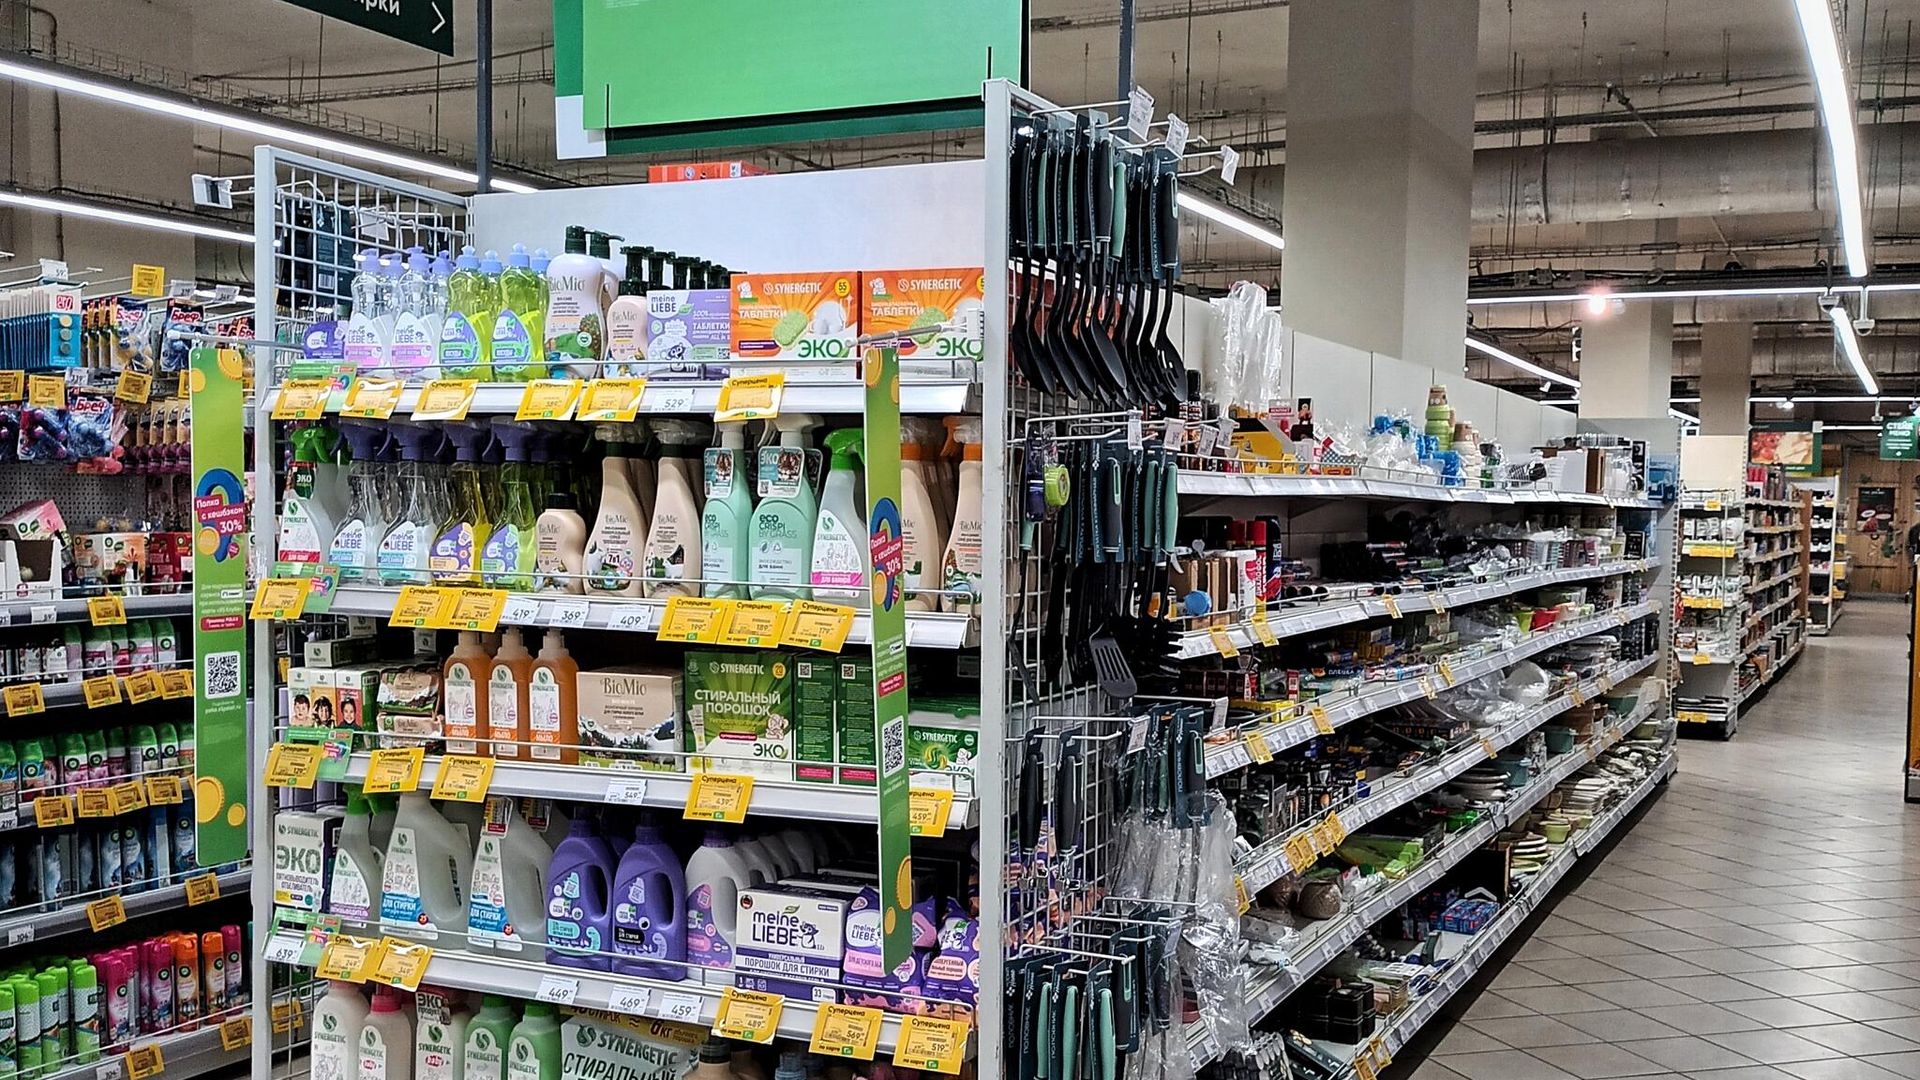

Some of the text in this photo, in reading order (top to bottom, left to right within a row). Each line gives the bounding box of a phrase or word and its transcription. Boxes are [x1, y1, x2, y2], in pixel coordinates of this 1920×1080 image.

[774, 282, 822, 294] SYNERGETIC
[838, 281, 848, 290] 55
[909, 279, 962, 291] SYNERGETIC
[651, 295, 676, 303] meine
[651, 303, 677, 313] LIEBE
[871, 307, 924, 317] ТАБЛЕТКИ
[172, 309, 200, 322] Бреф
[738, 310, 788, 319] ТАБЛЕТКИ
[692, 323, 731, 331] ТАБЛЕТКИ
[798, 339, 843, 358] ЭКО
[935, 338, 984, 357] ЭКО
[731, 377, 768, 387] Суперцена
[664, 399, 684, 408] 529
[760, 450, 778, 465] ЭКО
[296, 474, 312, 483] ЭКО
[196, 499, 219, 509] Полка
[207, 506, 243, 519] кешбэком
[704, 514, 717, 523] eco
[759, 514, 779, 523] eco
[219, 520, 243, 533] 30%
[758, 522, 786, 531] CRISPI
[758, 530, 798, 539] BY GRASS
[340, 539, 362, 549] LIEBE
[390, 541, 414, 550] LIEBE
[886, 557, 901, 573] 30%
[408, 587, 440, 595] Суперцена
[462, 589, 494, 597] Суперцена
[676, 599, 712, 608] Суперцена
[736, 602, 773, 611] Суперцена
[801, 602, 838, 613] Суперцена
[512, 608, 530, 617] 419
[561, 610, 581, 620] 369
[620, 615, 642, 626] 409
[720, 662, 764, 675] SYNERGETIC
[775, 666, 783, 674] 20
[603, 677, 647, 696] BioMio
[694, 689, 781, 705] СТИРАЛЬНЫЙ
[705, 702, 770, 716] ПОРОШОК
[921, 732, 958, 743] SYNERGETIC
[280, 744, 310, 752] Суперцена
[753, 743, 785, 757] ЭКО
[449, 757, 480, 766] Суперцена
[701, 775, 737, 784] Суперцена
[913, 812, 928, 821] 459
[287, 826, 319, 838] SYNERGETIC
[275, 845, 321, 874] ЭКО
[275, 872, 319, 885] ПЯТНОВЫВОДИТЕЛЬ
[382, 899, 416, 910] ДЛЯ СТИРКИ
[470, 907, 501, 921] ДЛЯ СТИРКИ
[753, 911, 799, 927] meine
[854, 924, 875, 933] meine
[752, 924, 798, 946] LIEBE
[851, 931, 875, 941] LIEBE
[275, 948, 294, 959] 639
[744, 957, 781, 970] ПОРОШОК
[782, 961, 799, 973] ДЛЯ
[800, 965, 830, 977] СТИРКИ
[548, 987, 569, 998] 449
[731, 990, 767, 1002] Суперцена
[814, 988, 822, 998] 33
[417, 993, 442, 1008] ЭКО
[619, 997, 640, 1008] 469
[671, 1005, 692, 1016] 459
[828, 1005, 865, 1017] Суперцена
[911, 1018, 951, 1030] Суперцена
[314, 1032, 346, 1044] SYNERGETIC
[846, 1030, 862, 1039] 569
[418, 1042, 451, 1055] SYNERGETIC
[597, 1031, 678, 1066] SYNERGETIC
[931, 1042, 945, 1052] 519
[466, 1050, 499, 1063] SYNERGETIC
[509, 1063, 537, 1076] SYNERGETIC
